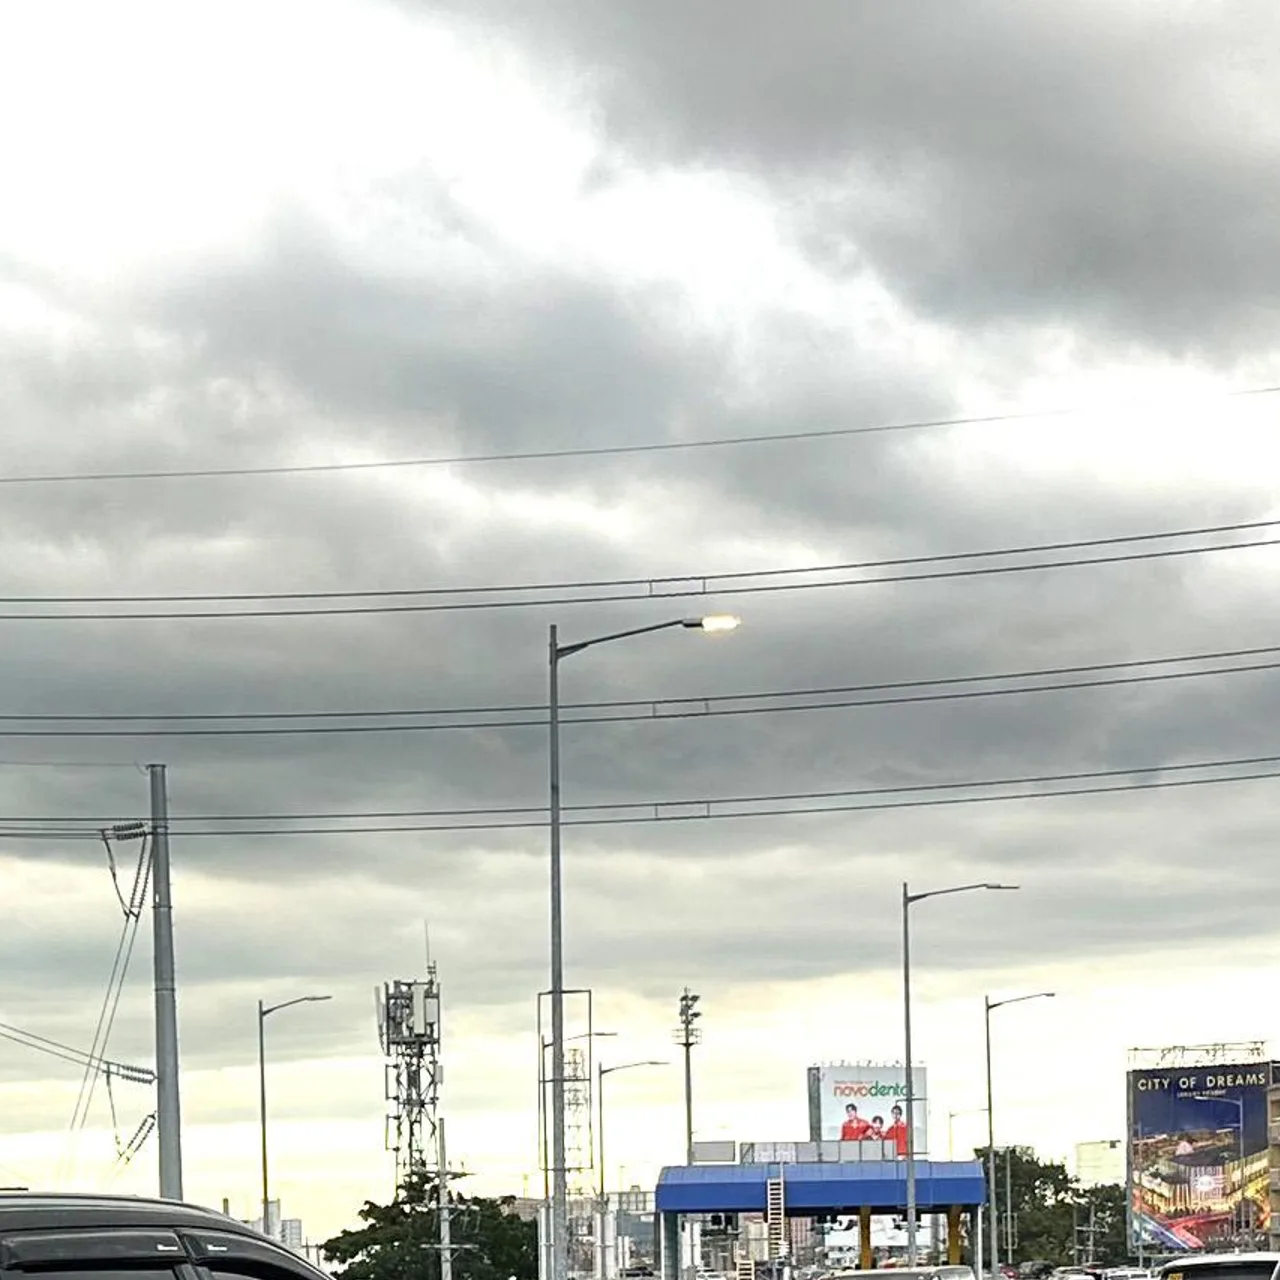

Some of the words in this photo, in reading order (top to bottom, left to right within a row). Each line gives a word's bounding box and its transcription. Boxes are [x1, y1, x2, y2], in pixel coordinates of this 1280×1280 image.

[833, 1081, 915, 1097] novodenta
[1137, 1077, 1170, 1091] CITY
[1178, 1076, 1197, 1089] OF
[1206, 1073, 1266, 1088] DREAMS
